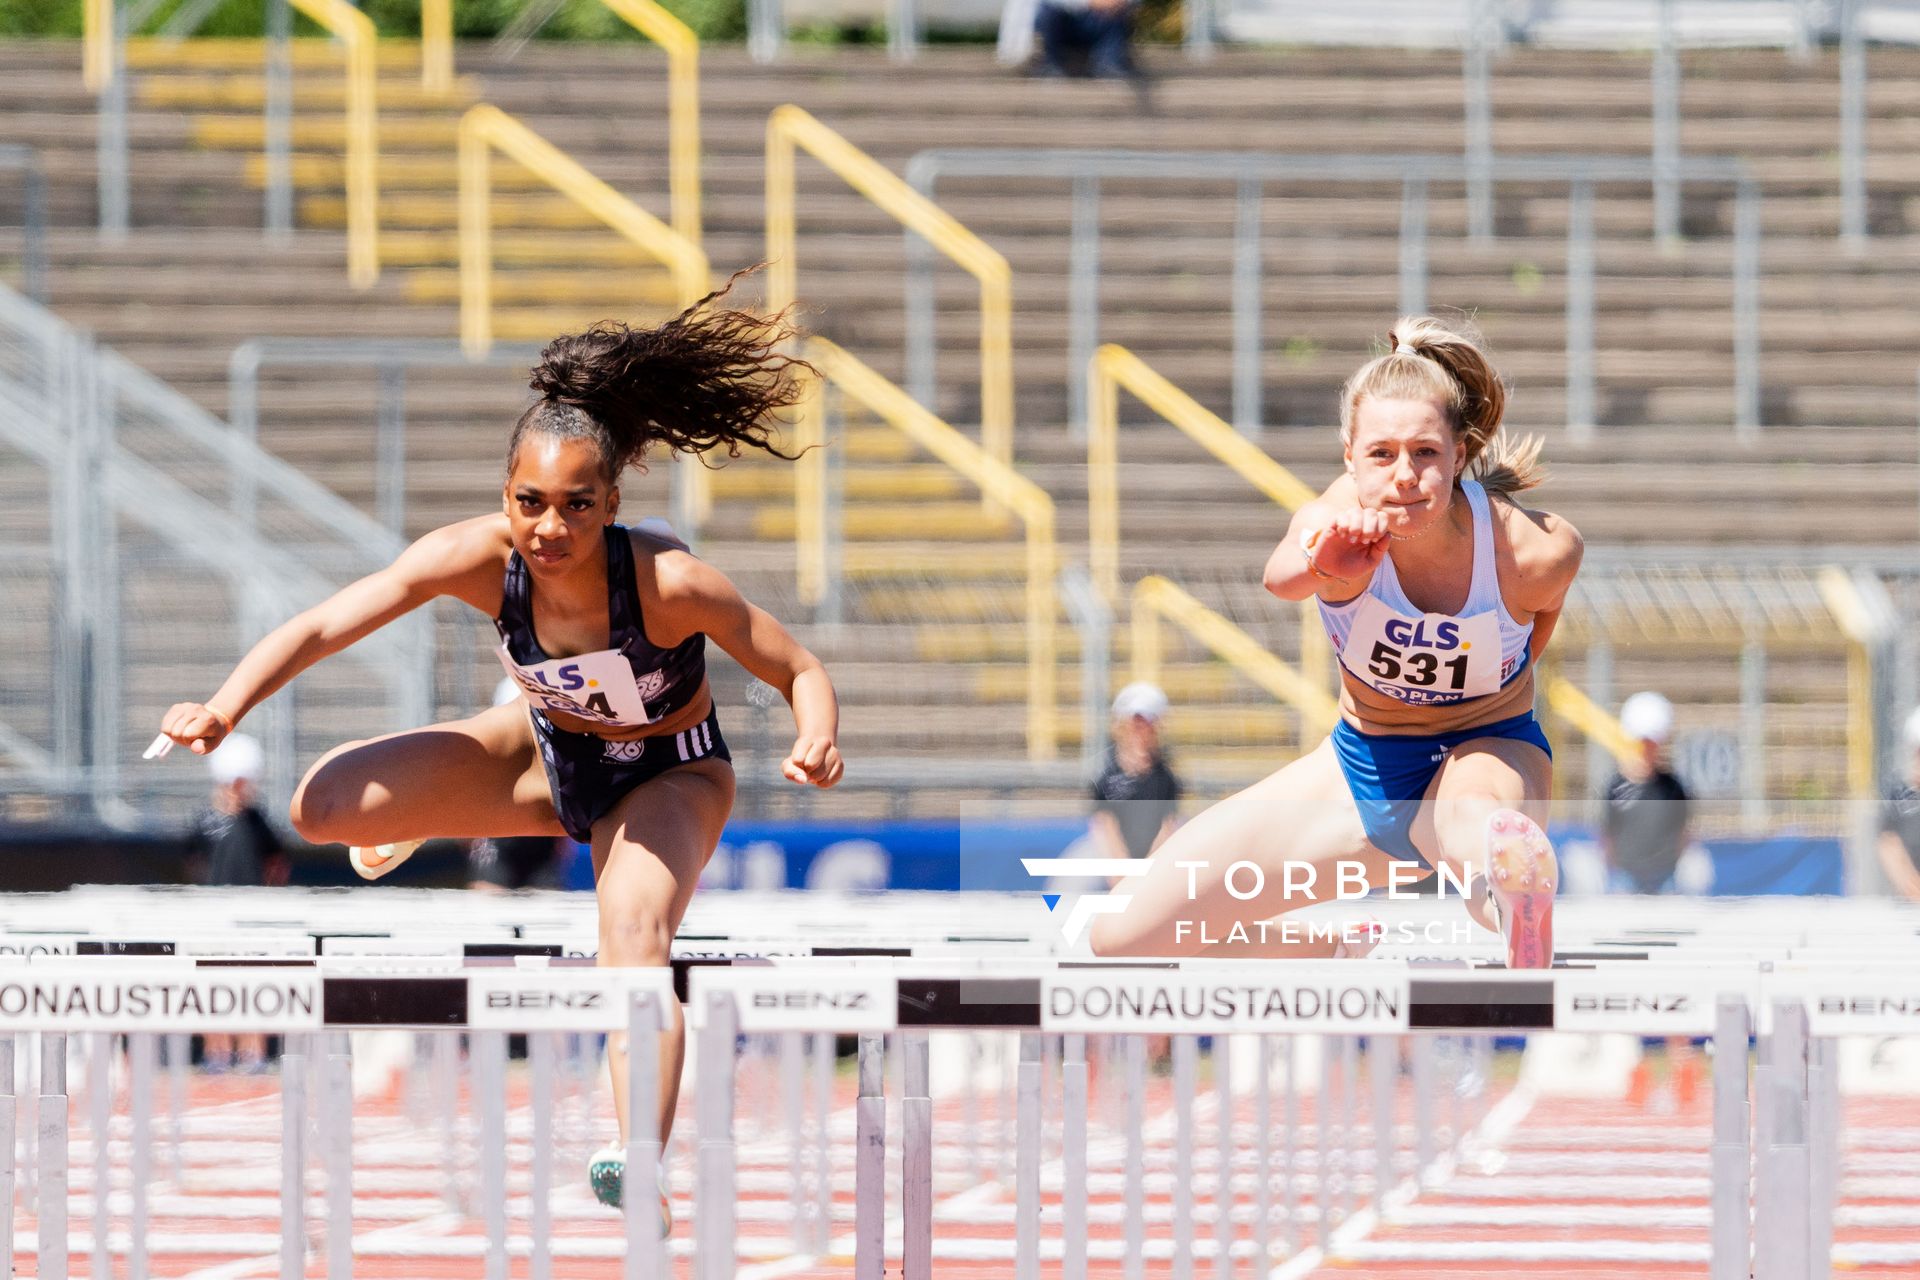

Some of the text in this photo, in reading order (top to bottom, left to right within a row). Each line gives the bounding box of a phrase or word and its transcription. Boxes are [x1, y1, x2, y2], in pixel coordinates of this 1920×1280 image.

[1385, 618, 1471, 651] GLS.
[1367, 640, 1468, 690] 531
[1409, 691, 1459, 703] PLAN
[0, 984, 314, 1016] ONAUSTADION
[485, 992, 602, 1010] BENZ
[752, 992, 868, 1010] BENZ
[1050, 986, 1398, 1020] DONAUSTADION
[1571, 995, 1688, 1013] BENZ
